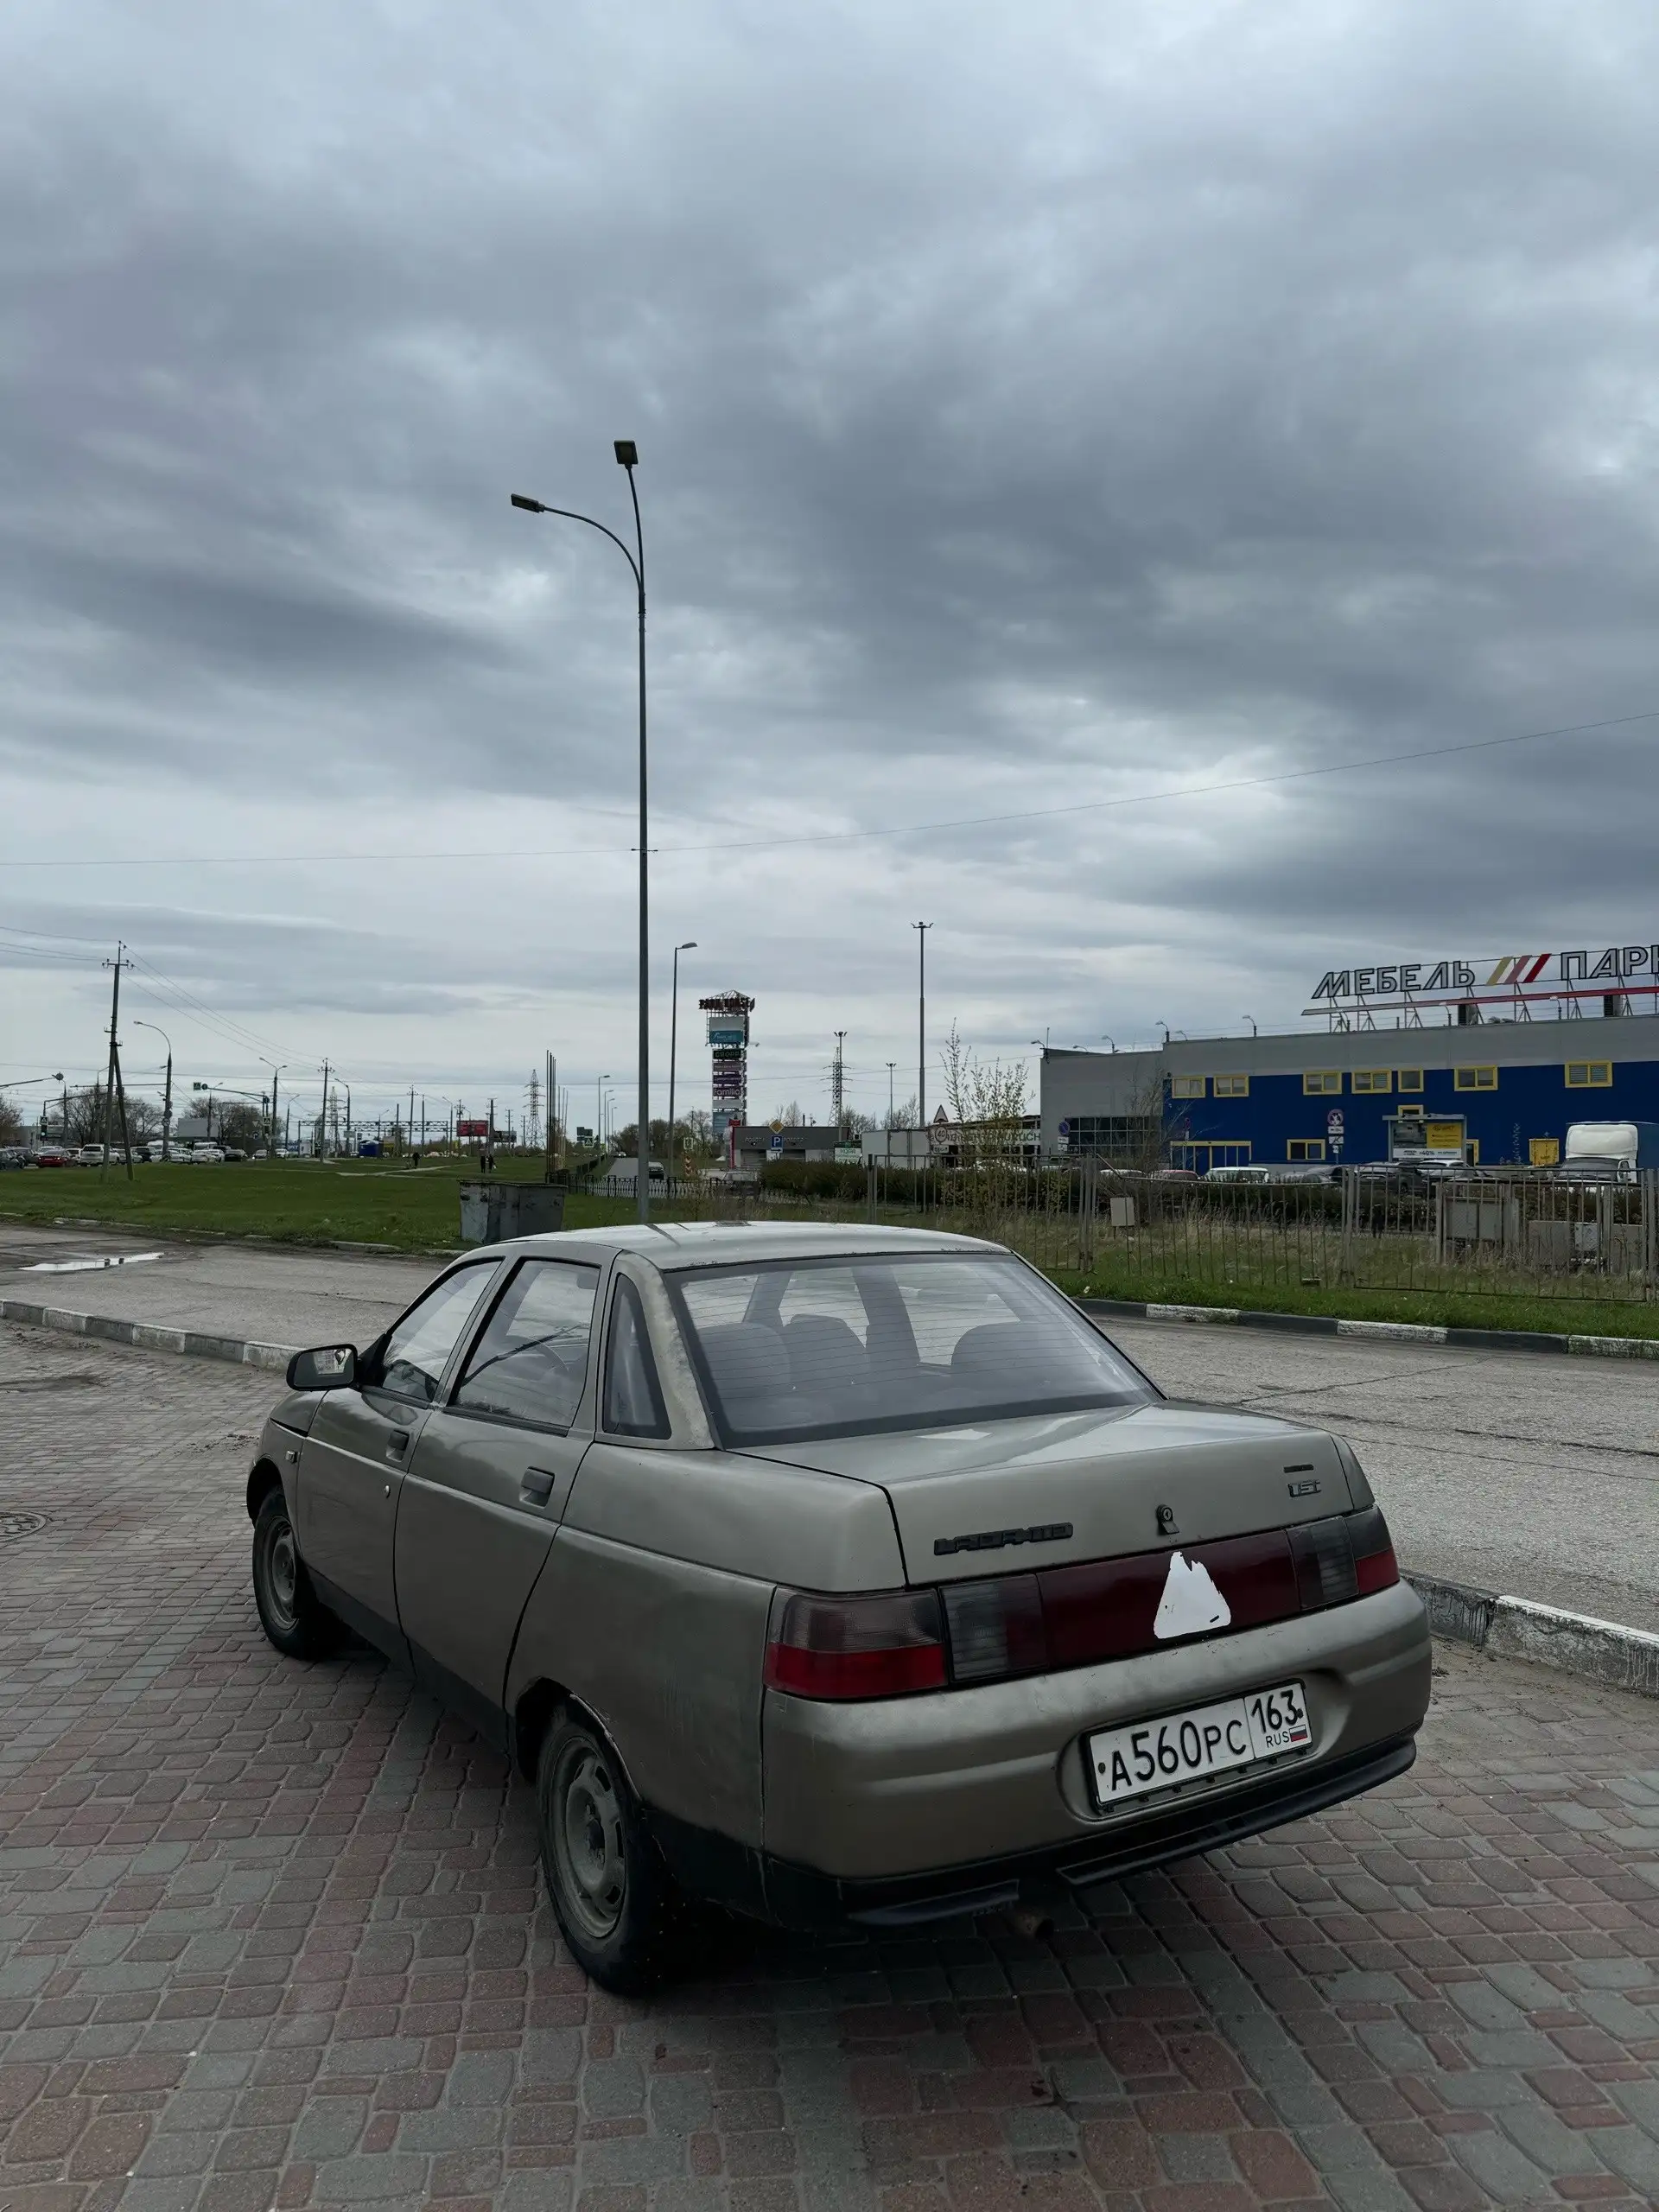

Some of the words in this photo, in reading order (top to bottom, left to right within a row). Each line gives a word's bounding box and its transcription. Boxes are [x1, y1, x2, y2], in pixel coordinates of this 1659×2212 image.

[1311, 961, 1475, 999] МЕБЕЛЬ
[1111, 1719, 1247, 1790] А560РС
[1250, 1689, 1298, 1733] 163
[1265, 1734, 1290, 1748] RUS
